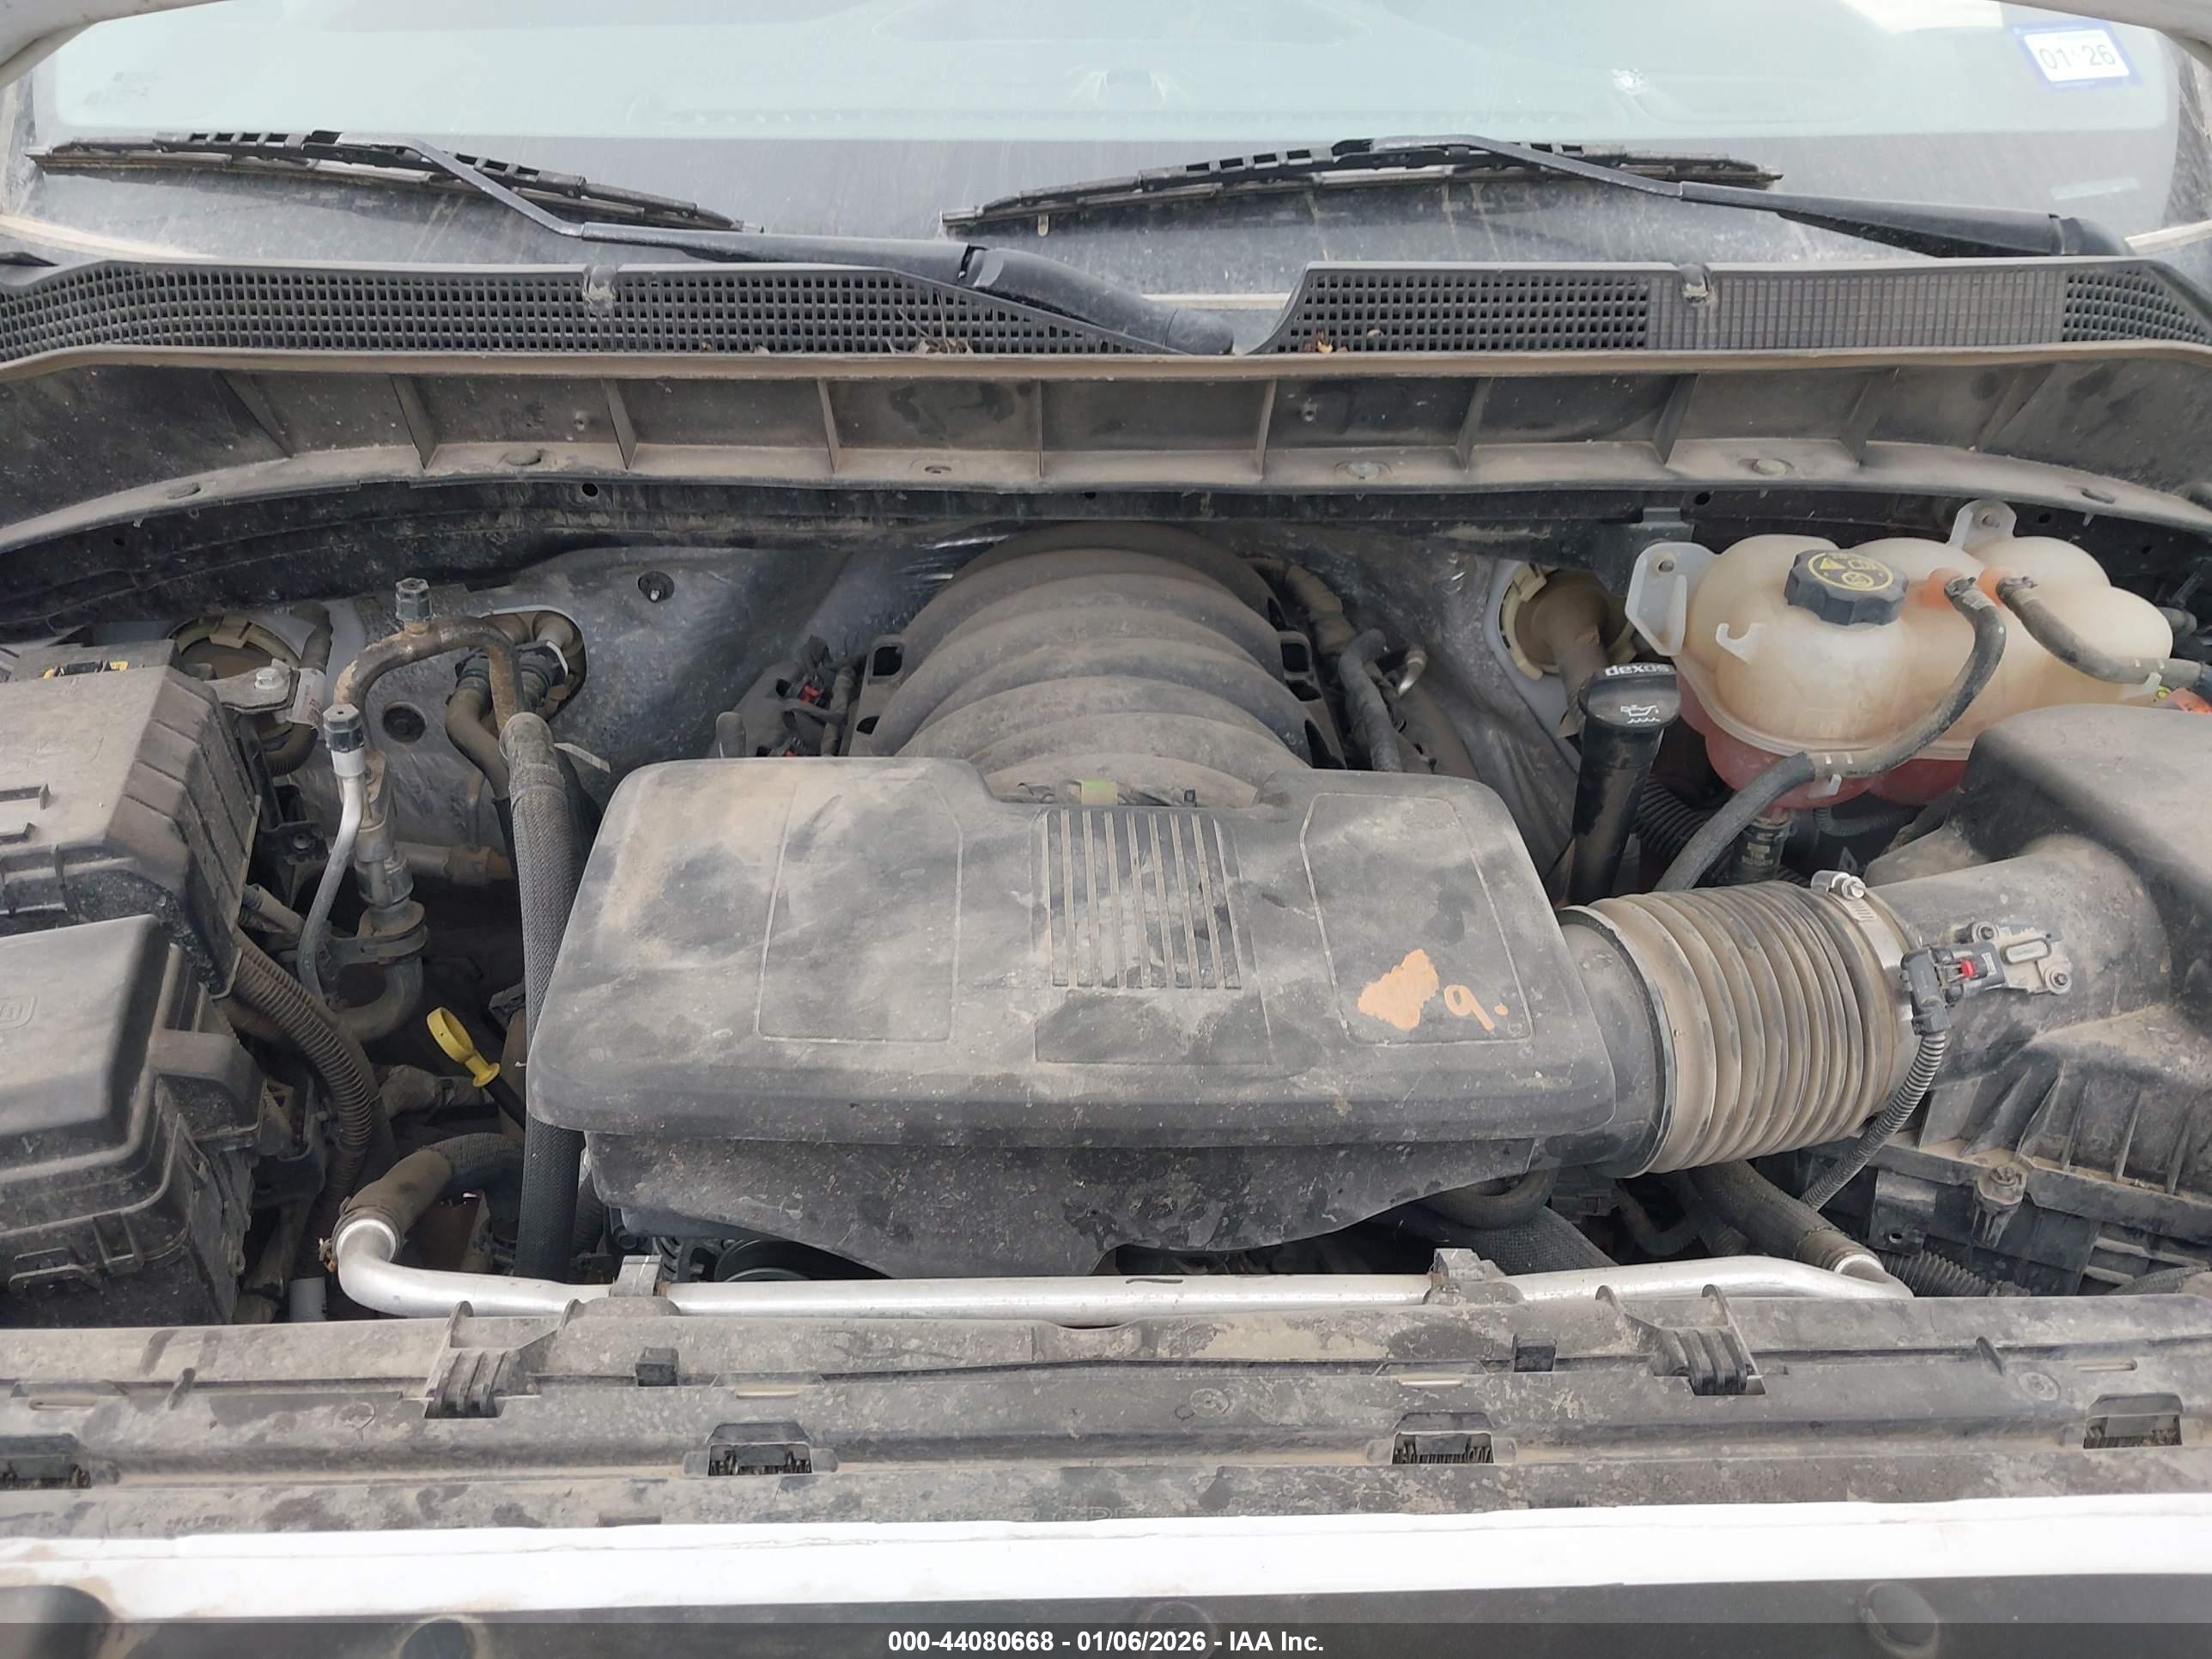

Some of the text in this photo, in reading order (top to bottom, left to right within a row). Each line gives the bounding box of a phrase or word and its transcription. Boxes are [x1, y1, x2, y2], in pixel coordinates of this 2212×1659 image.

[2039, 44, 2116, 69] 01 26
[1604, 665, 1670, 677] dexos
